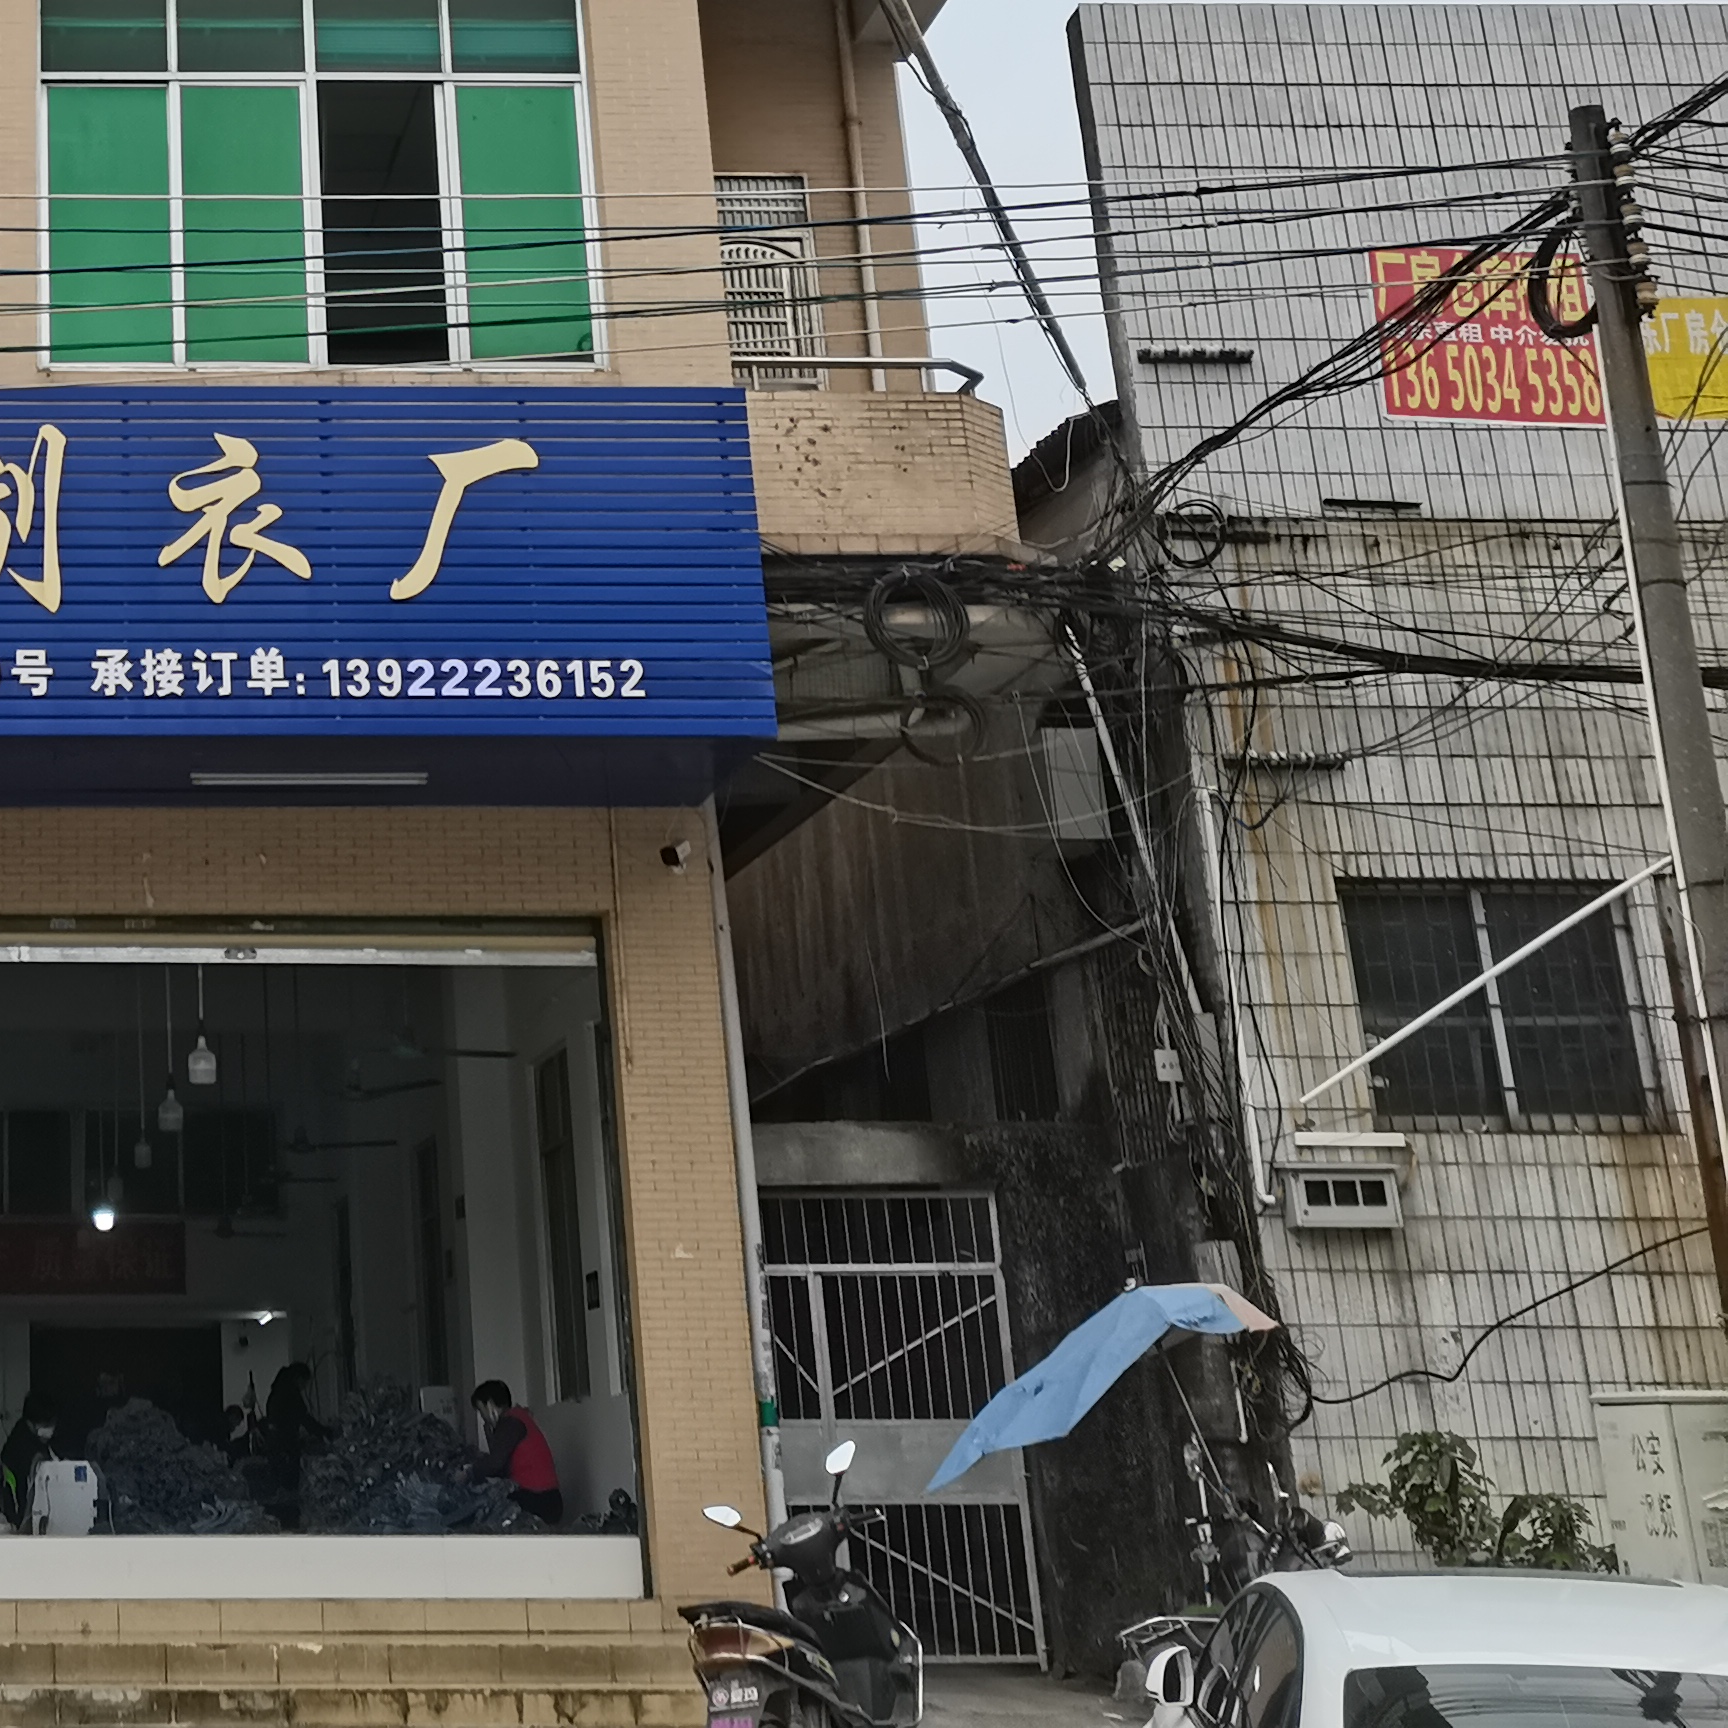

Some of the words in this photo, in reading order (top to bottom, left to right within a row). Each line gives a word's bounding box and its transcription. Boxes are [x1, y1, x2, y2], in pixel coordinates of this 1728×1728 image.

[1384, 341, 1441, 411] 136
[1445, 344, 1521, 414] 5034
[1524, 347, 1602, 418] 5358
